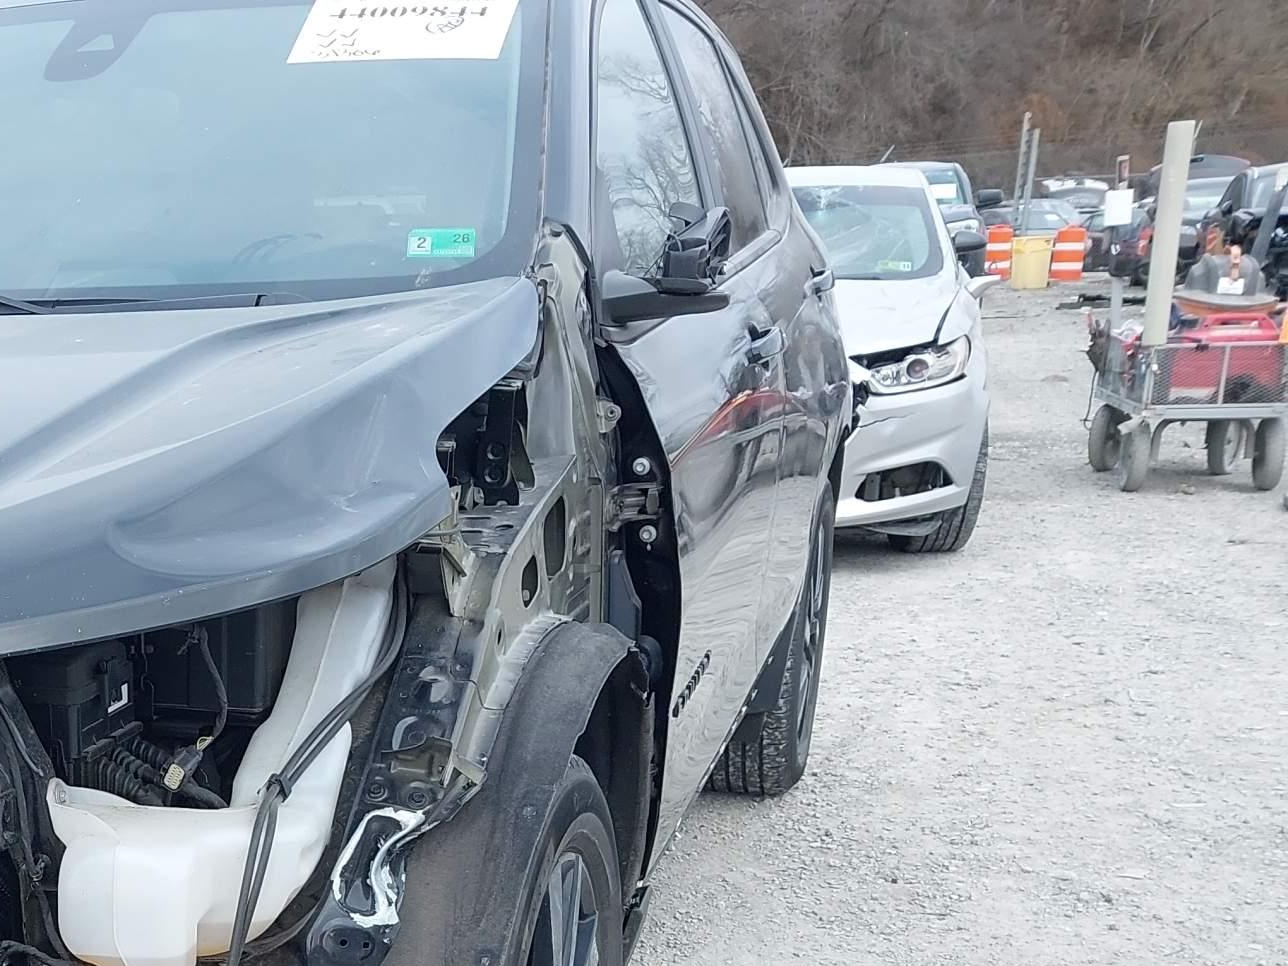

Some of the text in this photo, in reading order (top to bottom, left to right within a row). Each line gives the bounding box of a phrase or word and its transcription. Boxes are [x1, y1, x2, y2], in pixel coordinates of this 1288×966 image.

[329, 6, 489, 19] 44009844
[416, 236, 427, 249] 2
[453, 233, 471, 244] 26
